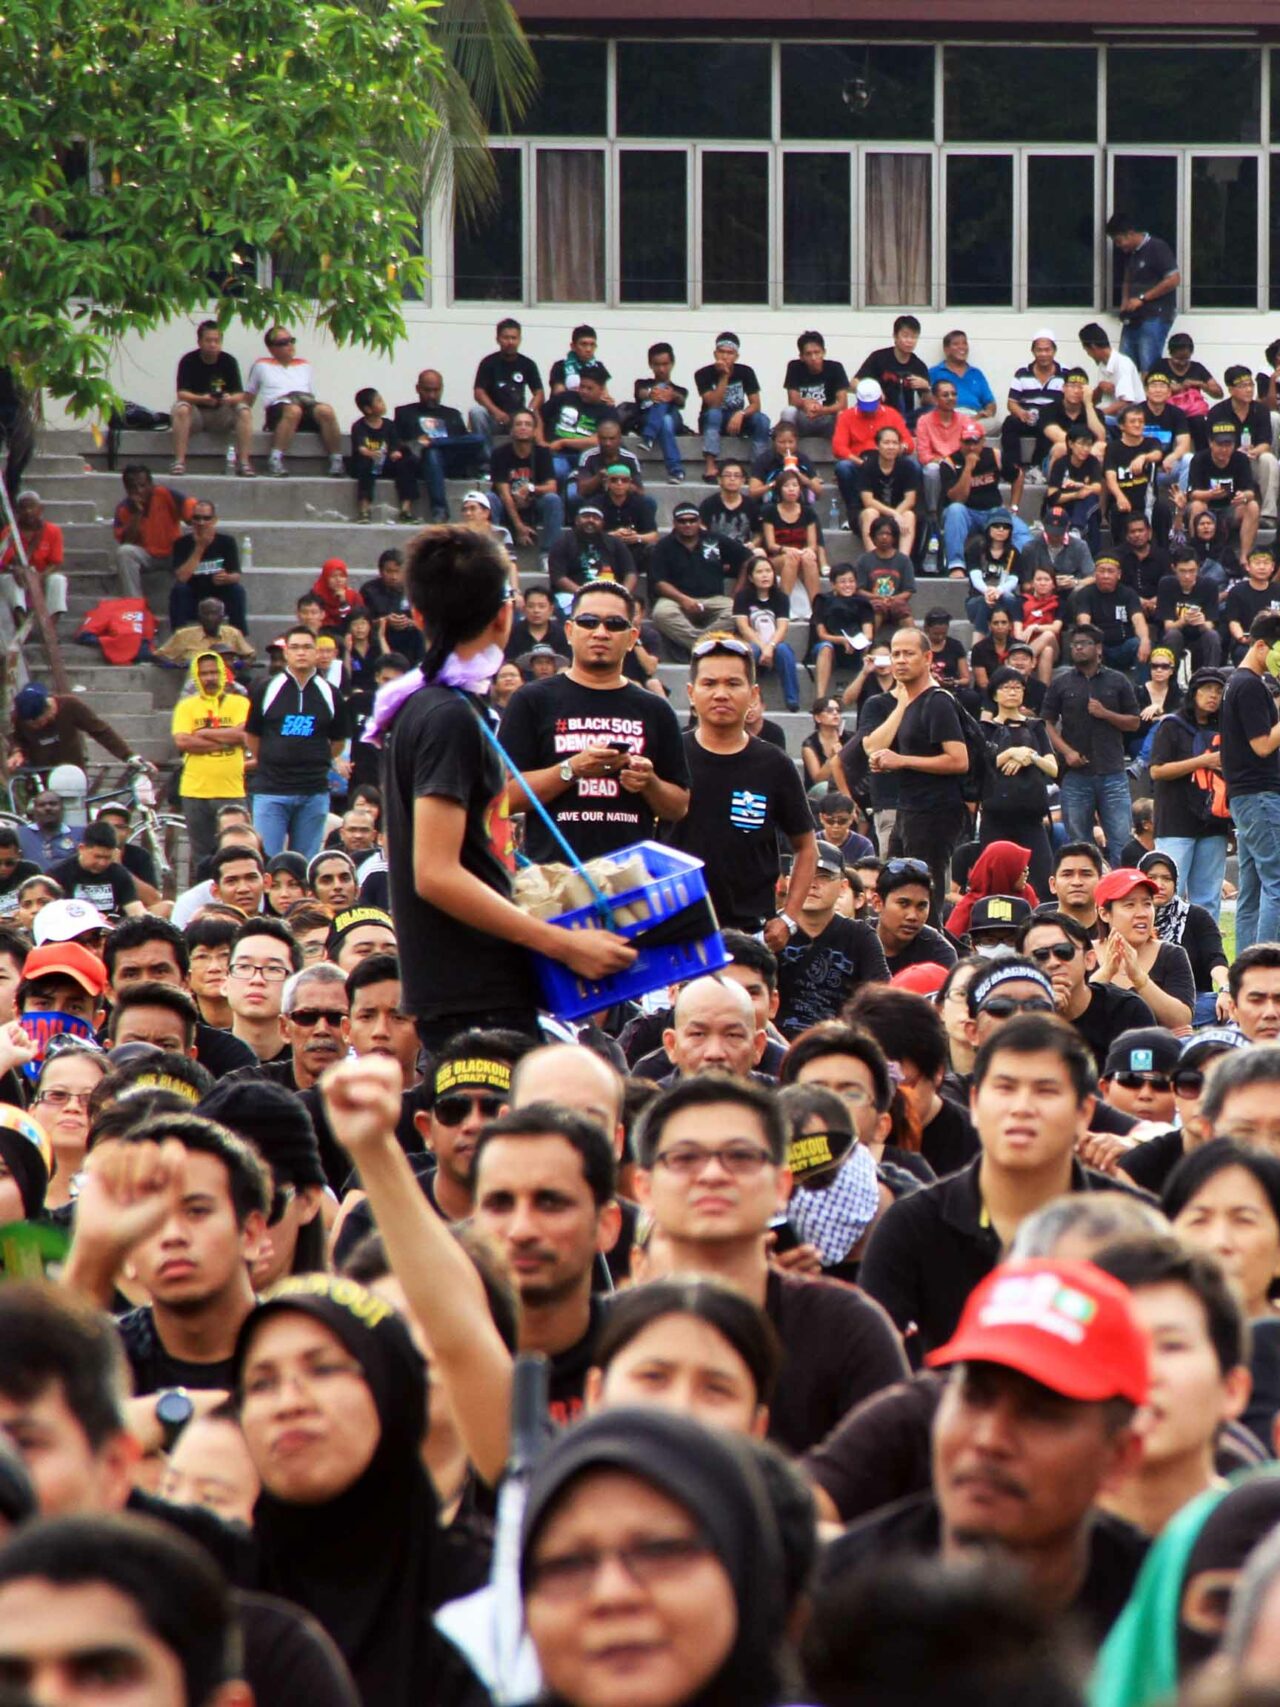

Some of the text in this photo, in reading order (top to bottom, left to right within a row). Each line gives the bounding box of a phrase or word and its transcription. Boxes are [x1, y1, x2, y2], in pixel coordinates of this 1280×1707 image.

[282, 715, 315, 728] 505
[578, 778, 618, 797] DEAD
[557, 812, 638, 823] SAVE OUR NATION
[453, 1058, 510, 1079] BLACKOUT
